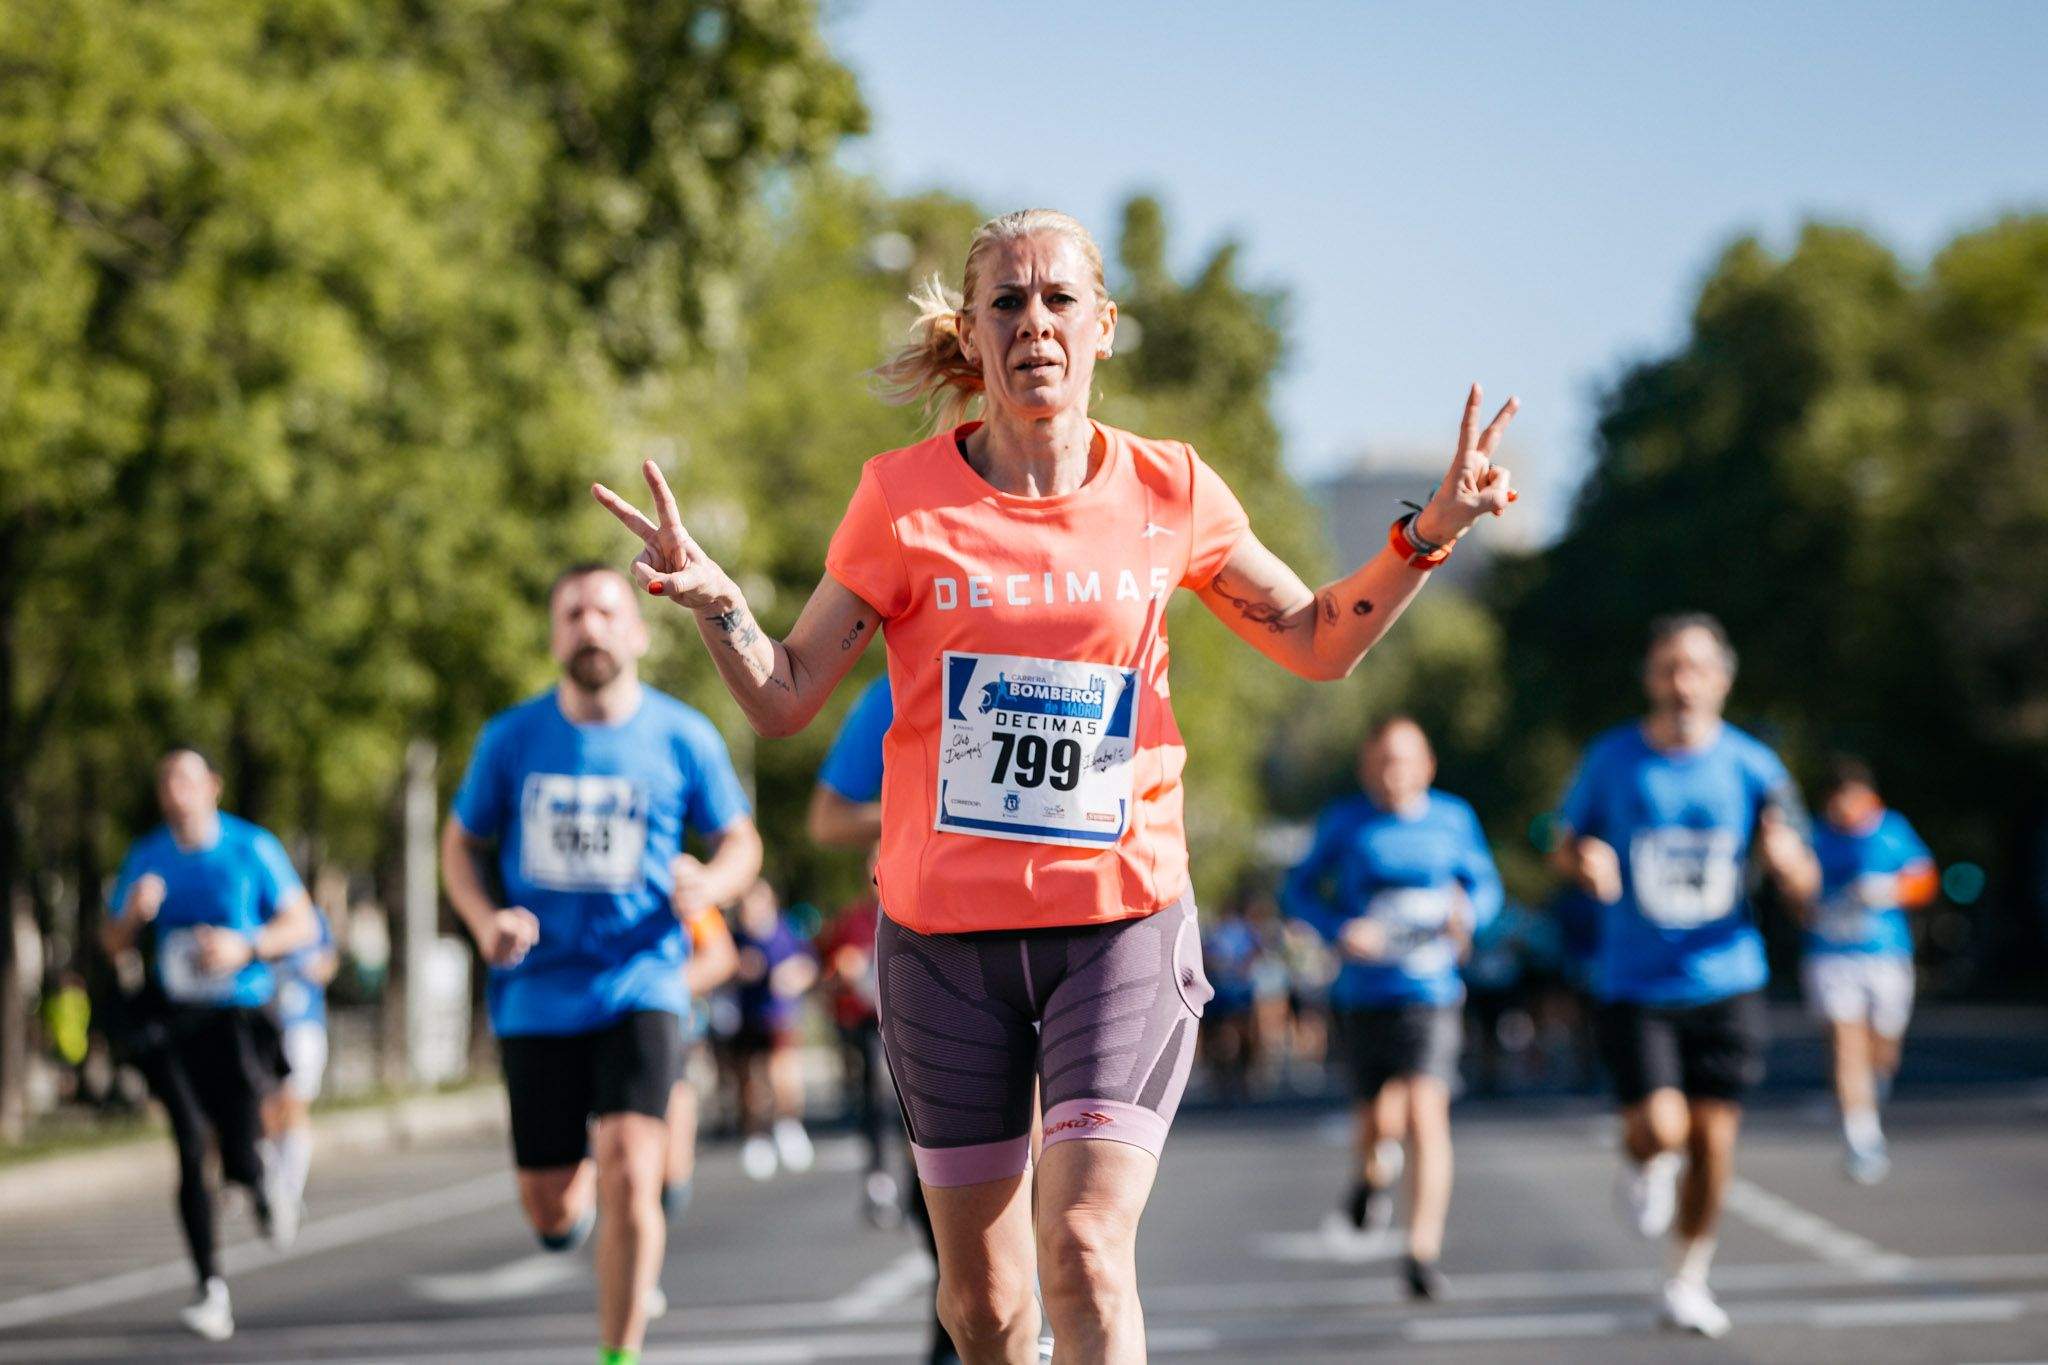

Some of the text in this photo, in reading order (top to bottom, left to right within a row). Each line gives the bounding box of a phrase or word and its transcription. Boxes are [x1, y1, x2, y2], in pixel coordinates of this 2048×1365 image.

[933, 567, 1171, 611] DECIMAS
[1009, 683, 1102, 705] BOMBEROS
[1061, 703, 1101, 718] MADRID
[995, 711, 1097, 735] DECIMAS
[991, 731, 1081, 791] 799
